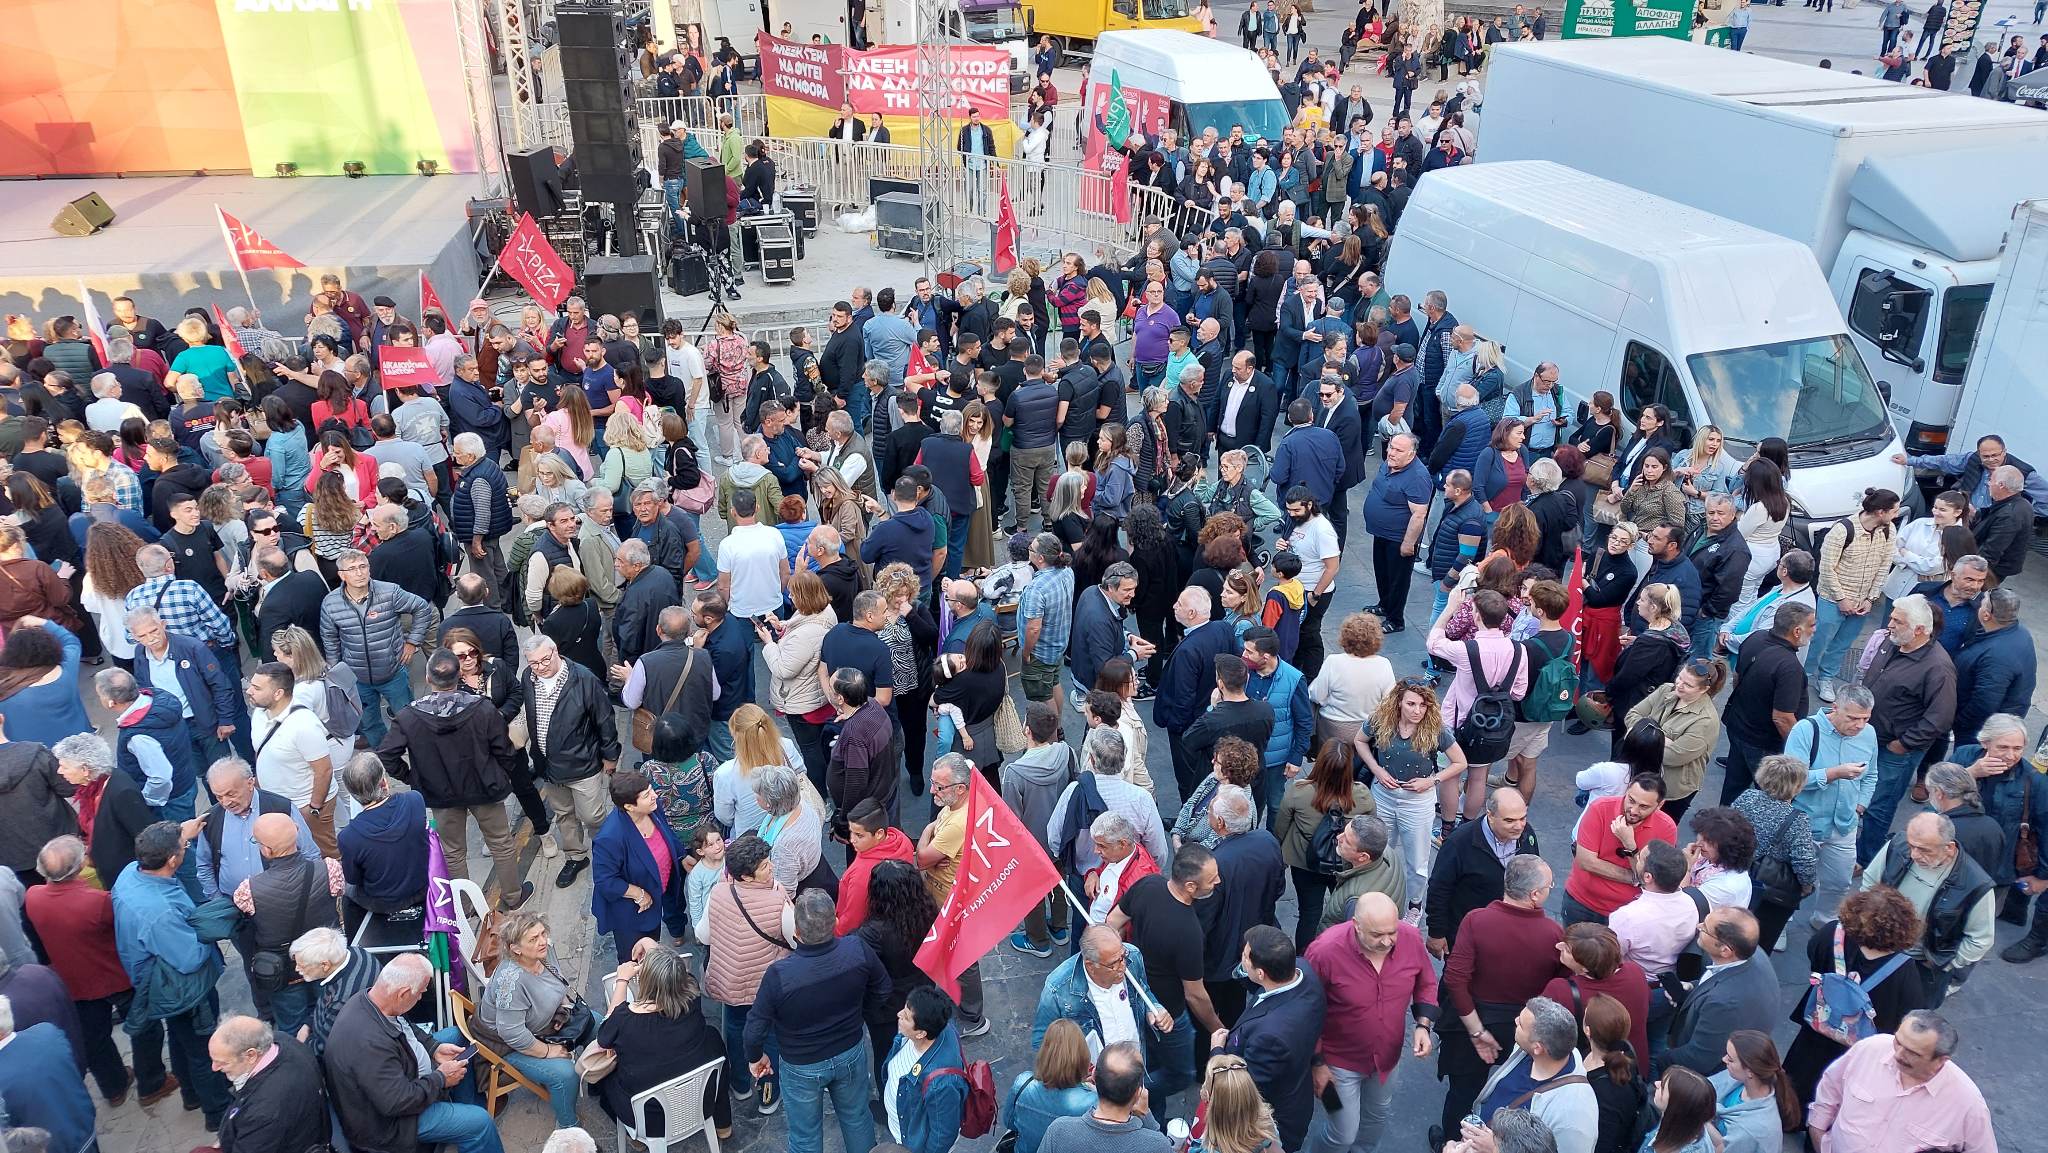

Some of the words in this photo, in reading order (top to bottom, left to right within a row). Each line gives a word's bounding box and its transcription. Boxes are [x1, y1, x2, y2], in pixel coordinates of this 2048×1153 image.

[1637, 8, 1681, 20] ΑΠΟΦΑΣΗ
[1637, 20, 1678, 30] ΑΛΛΑΓΗΣ
[779, 58, 794, 74] ΝΑ
[794, 62, 823, 81] ΦΥΓΕΙ
[848, 58, 909, 74] ΑΛΕΞΗ
[915, 60, 1009, 76] ΠΟΧΩΡΑ
[783, 76, 830, 101] ΣΥΜΦΟΡΑ
[848, 75, 875, 90] ΝΑ
[884, 93, 910, 108] ΤΗ
